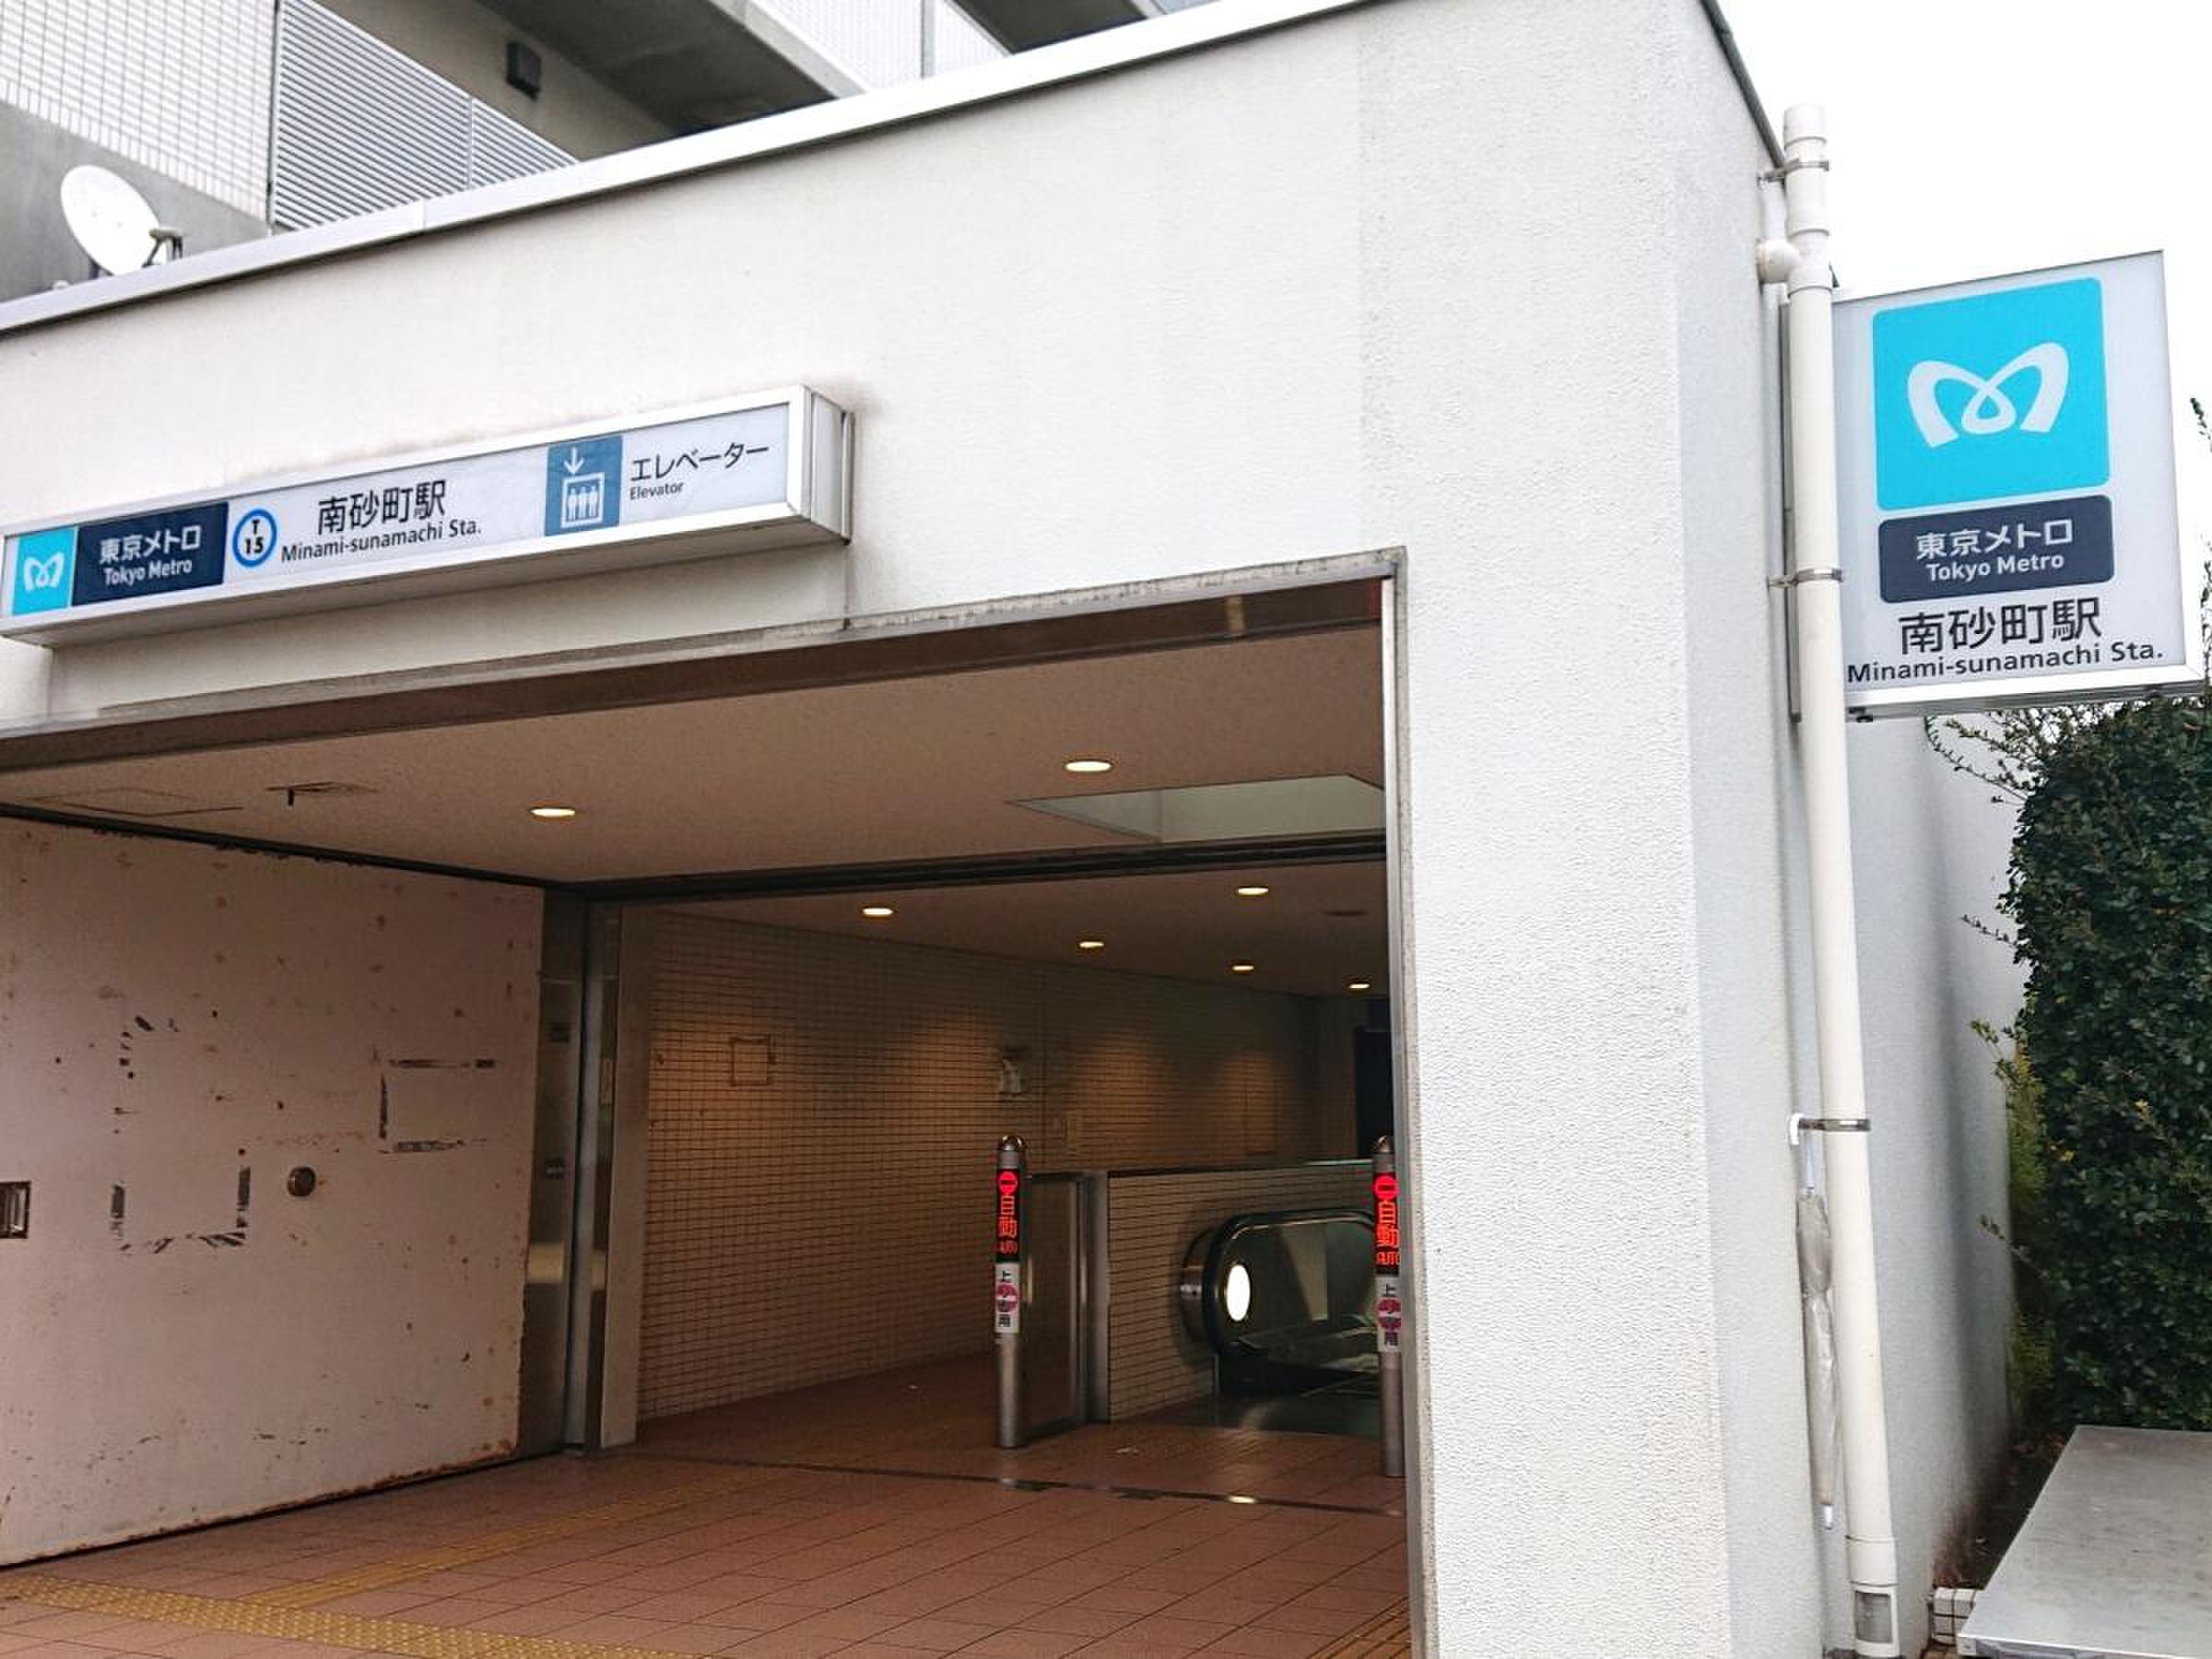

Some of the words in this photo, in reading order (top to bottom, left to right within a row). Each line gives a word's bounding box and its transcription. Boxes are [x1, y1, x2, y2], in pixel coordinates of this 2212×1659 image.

[630, 442, 770, 482] エレベーター
[318, 479, 446, 535] 南砂町駅
[629, 481, 684, 500] Elevator
[99, 525, 201, 565] 東京メトロ
[244, 536, 264, 555] 15
[251, 519, 261, 535] T
[281, 524, 442, 563] Minami-sunamachi
[449, 517, 481, 537] Sta.
[1916, 519, 2074, 560] 東京メトロ
[104, 563, 146, 586] Tokyo
[148, 558, 192, 578] Metro
[1925, 559, 1992, 582] Tokyo
[1996, 553, 2065, 575] Metro
[1899, 596, 2102, 655] 南砂町駅
[1848, 644, 2100, 683] Minami-sunamachi
[2111, 641, 2163, 662] Sta.
[1376, 1202, 1399, 1248] 自動
